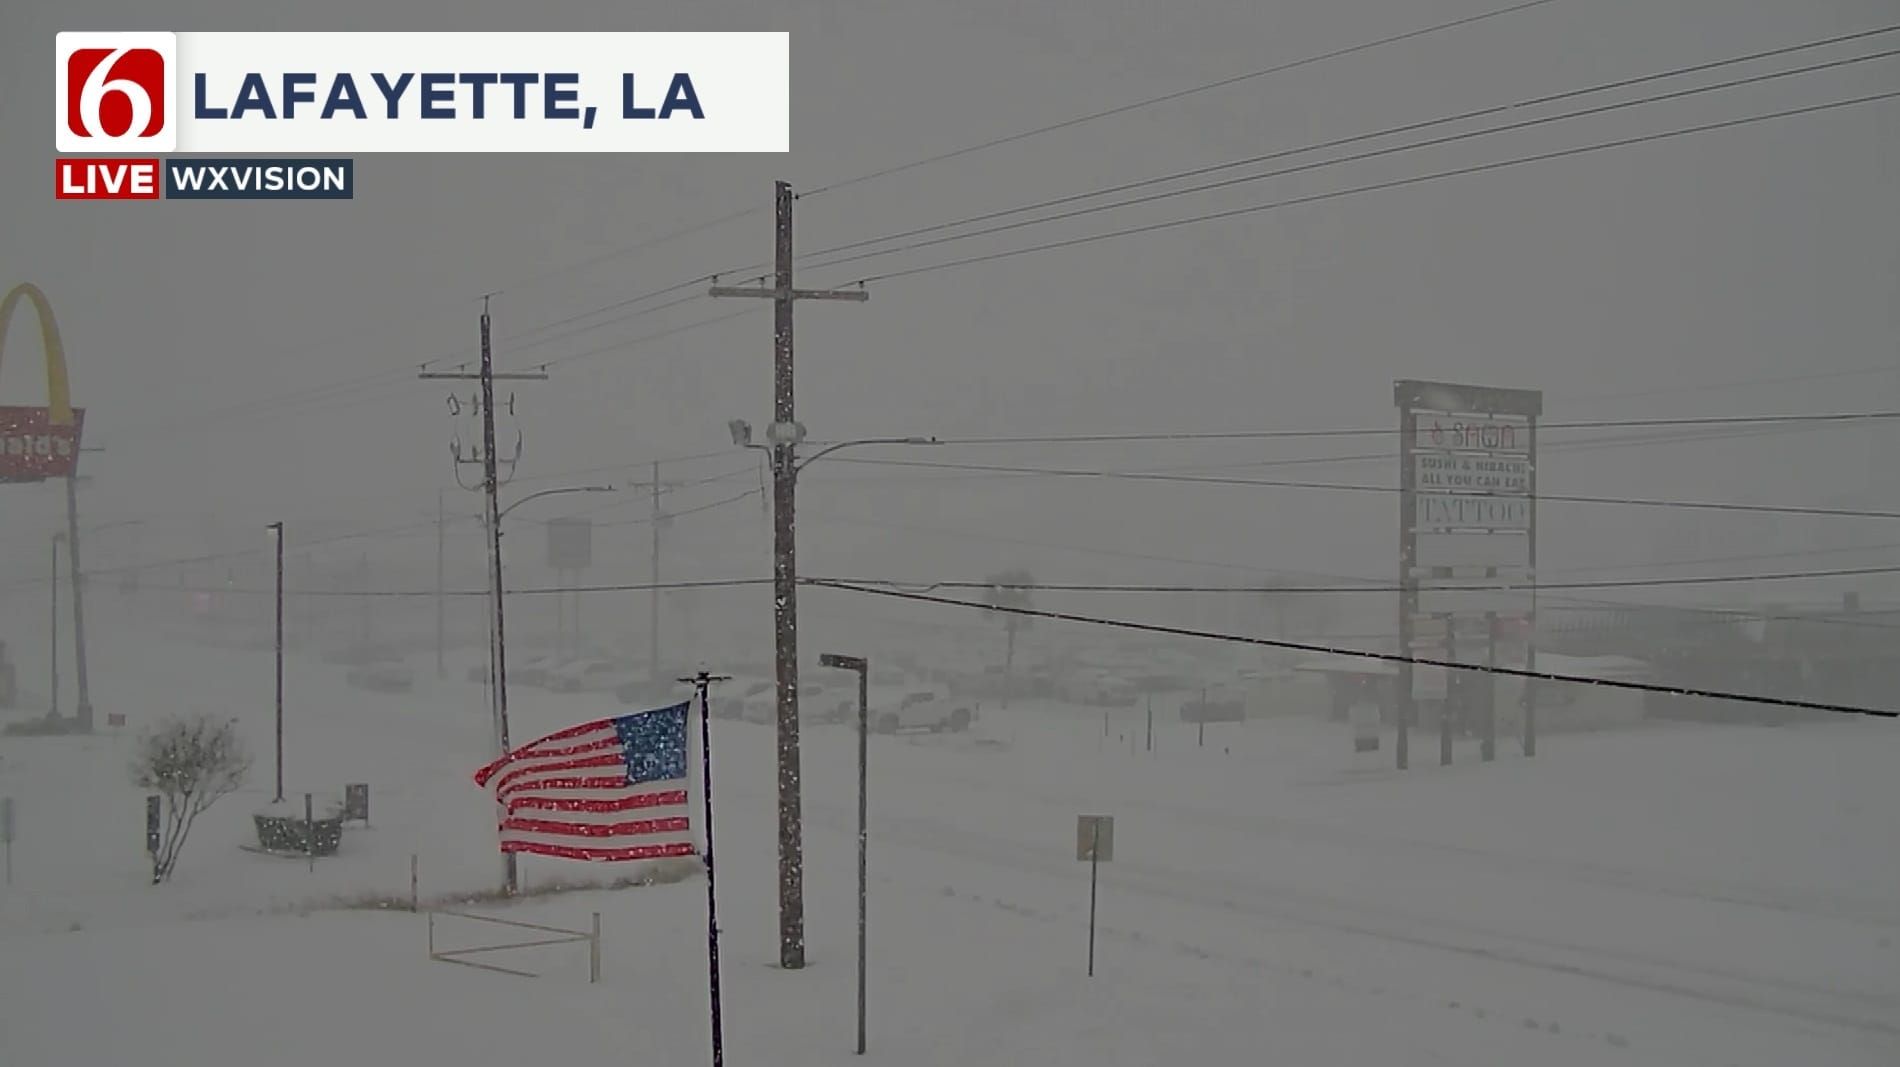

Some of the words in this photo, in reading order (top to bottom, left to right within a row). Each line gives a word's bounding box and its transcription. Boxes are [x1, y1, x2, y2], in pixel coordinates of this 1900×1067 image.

[1421, 457, 1457, 470] SUSHI
[1462, 461, 1471, 470] &
[1421, 472, 1440, 484] ALL
[1446, 474, 1472, 486] YOU
[1476, 476, 1501, 487] CAN
[1419, 497, 1526, 523] TATTOO
